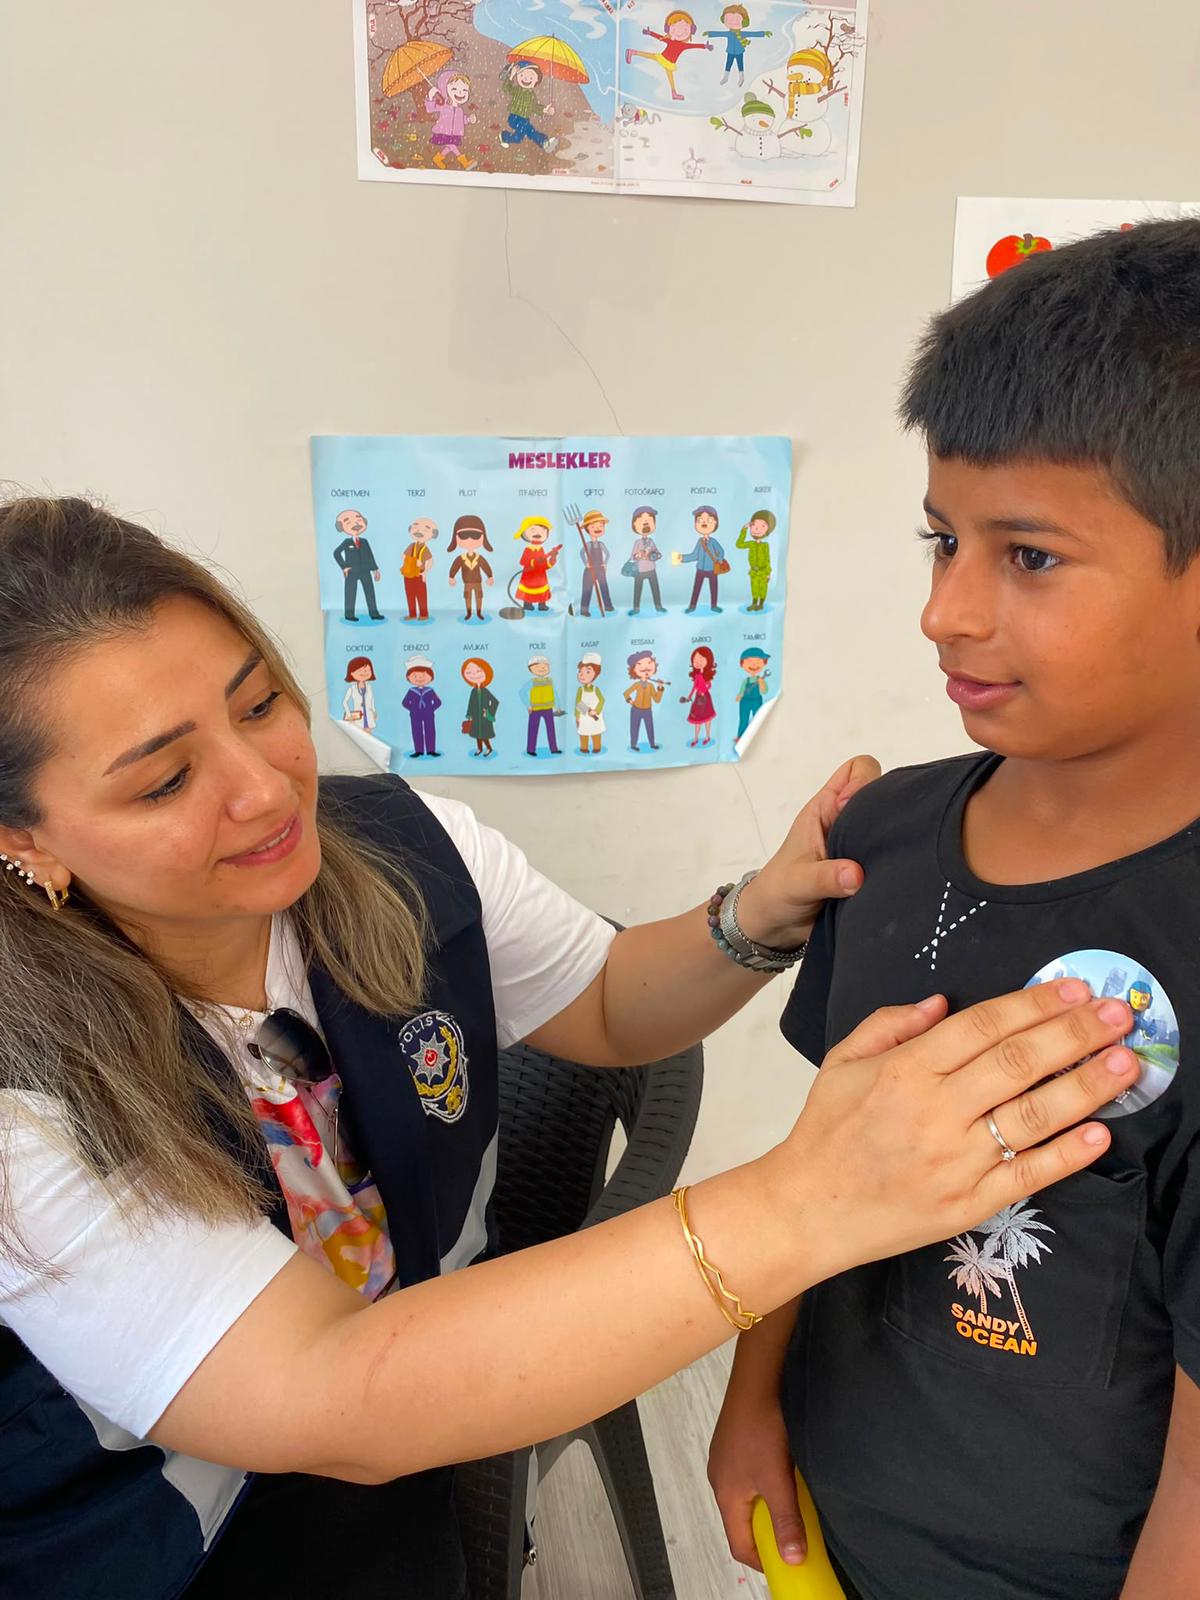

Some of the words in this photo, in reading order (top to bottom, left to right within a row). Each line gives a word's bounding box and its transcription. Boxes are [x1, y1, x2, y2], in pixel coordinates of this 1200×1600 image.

[508, 452, 611, 469] MESLEKLER
[330, 488, 370, 497] ÖĞRETMEN
[690, 487, 717, 495] POSTACI
[345, 644, 374, 652] DOKTOR
[463, 643, 489, 651] AVUKAT
[580, 640, 600, 648] KASAP
[951, 1302, 1020, 1335] SANDY
[956, 1321, 1038, 1356] OCEAN
